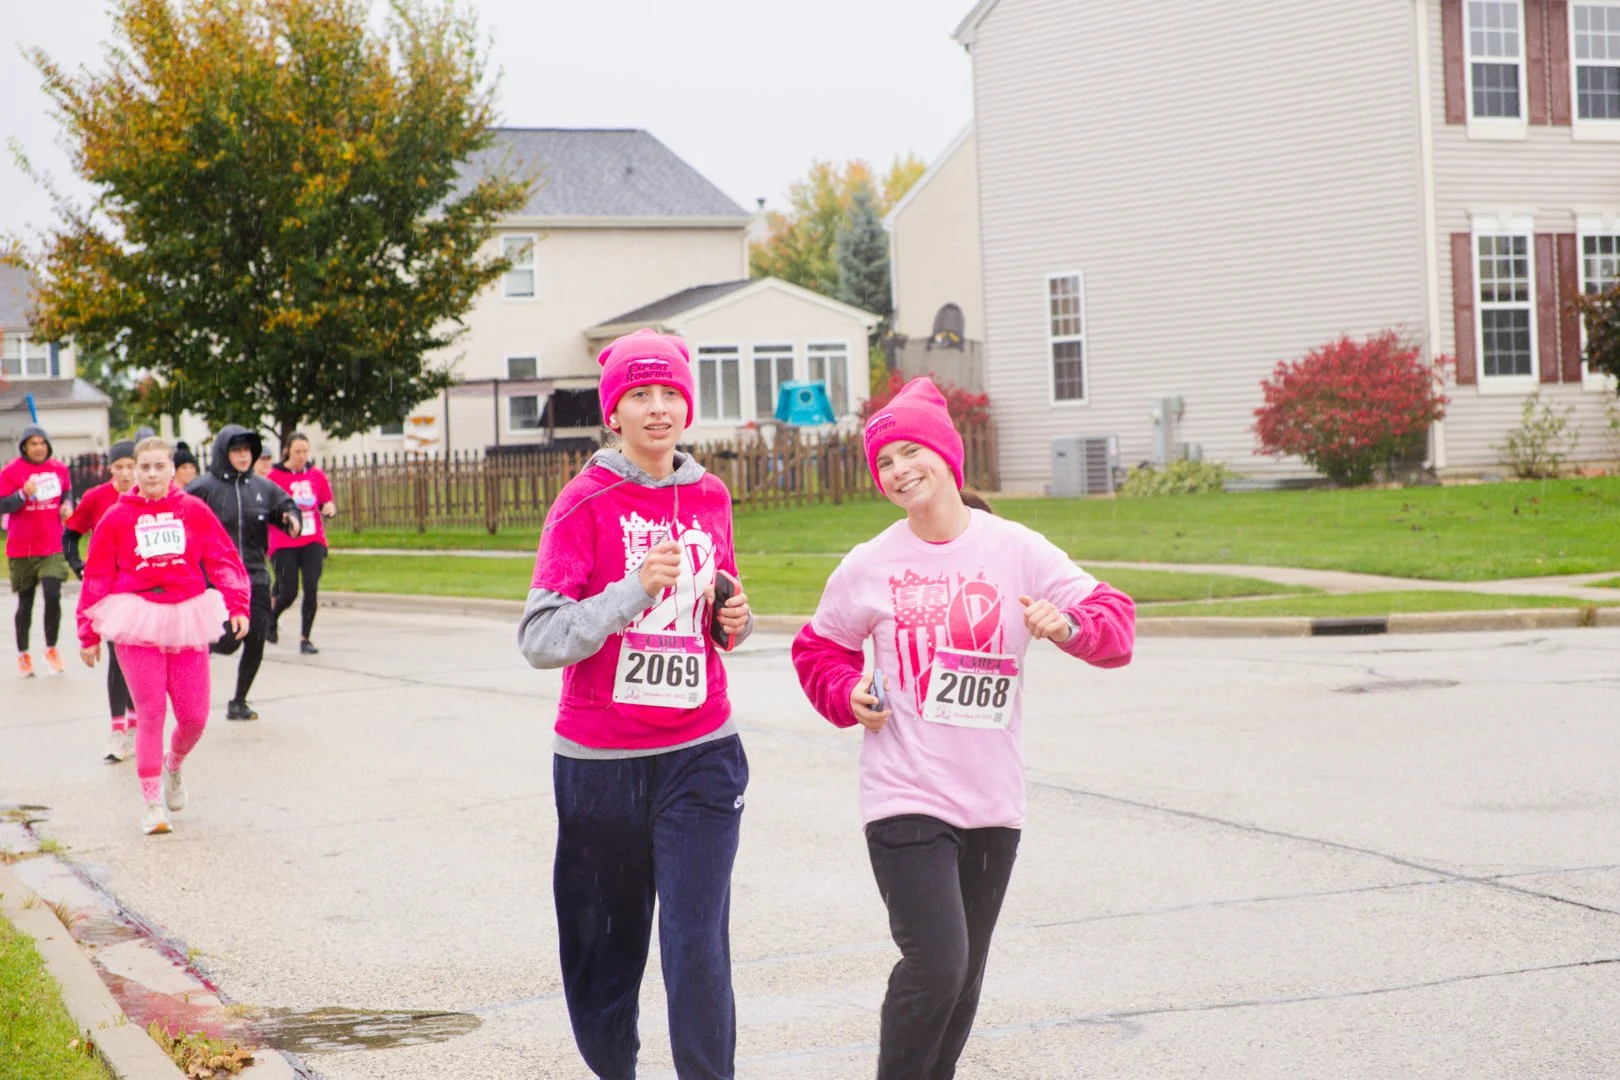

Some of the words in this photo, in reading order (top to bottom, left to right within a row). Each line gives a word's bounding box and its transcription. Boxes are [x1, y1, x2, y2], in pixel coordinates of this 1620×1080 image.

[628, 363, 670, 372] EXPERT
[627, 371, 673, 382] ROOFING
[143, 530, 181, 547] 1706
[624, 652, 700, 688] 2069
[936, 672, 1010, 708] 2068
